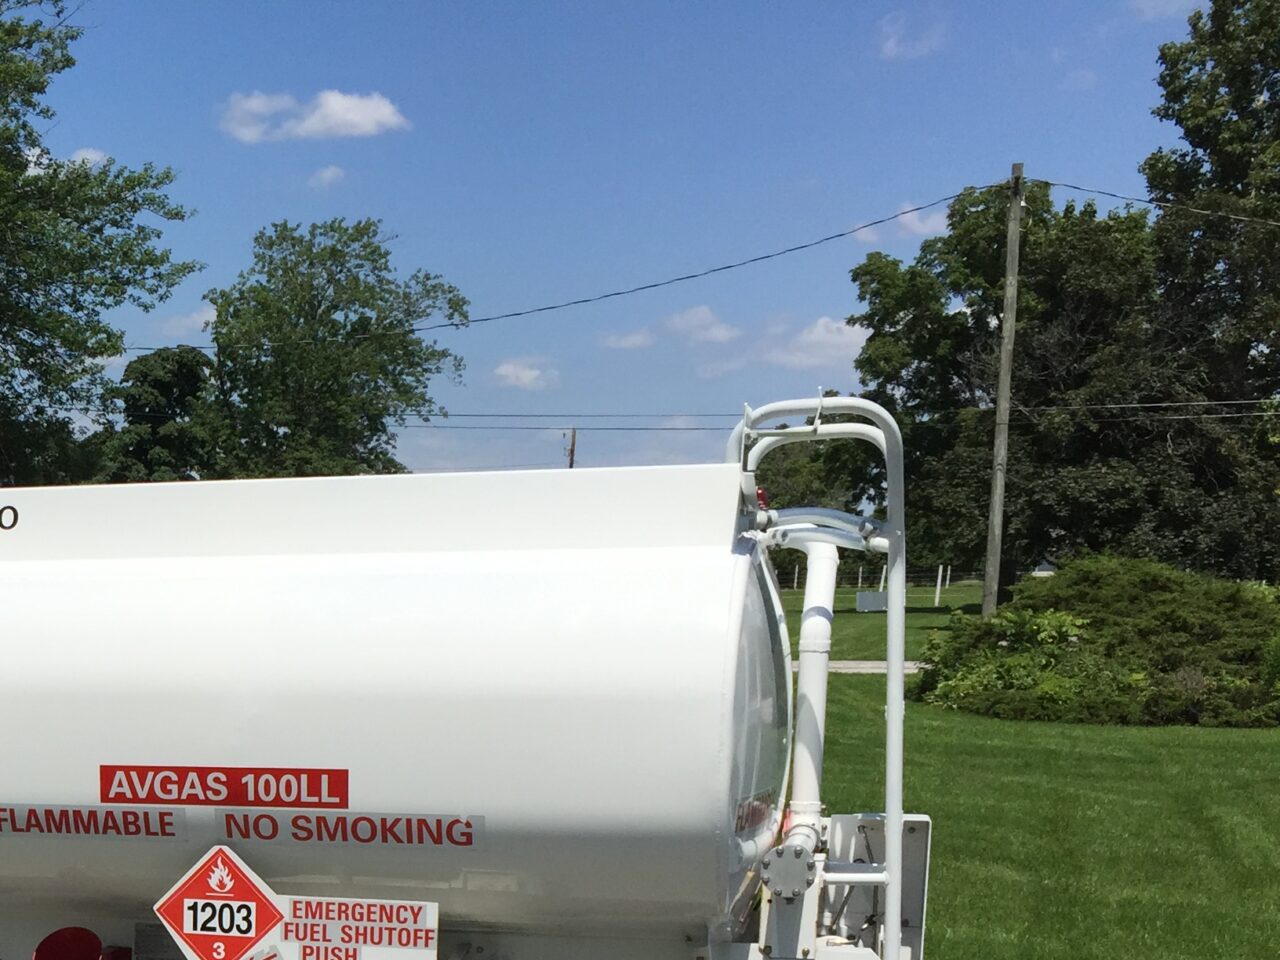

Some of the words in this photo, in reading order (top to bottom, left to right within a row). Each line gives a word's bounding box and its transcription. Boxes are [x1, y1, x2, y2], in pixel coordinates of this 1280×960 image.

[108, 770, 229, 801] AVGAS
[241, 773, 340, 804] 100LL
[225, 813, 279, 841] NO
[291, 815, 473, 847] SMOKING
[187, 901, 253, 935] 1203
[292, 900, 423, 925] EMERGENCY
[283, 922, 332, 943] FUEL
[340, 925, 435, 948] SHUTOFF
[212, 941, 227, 960] 3
